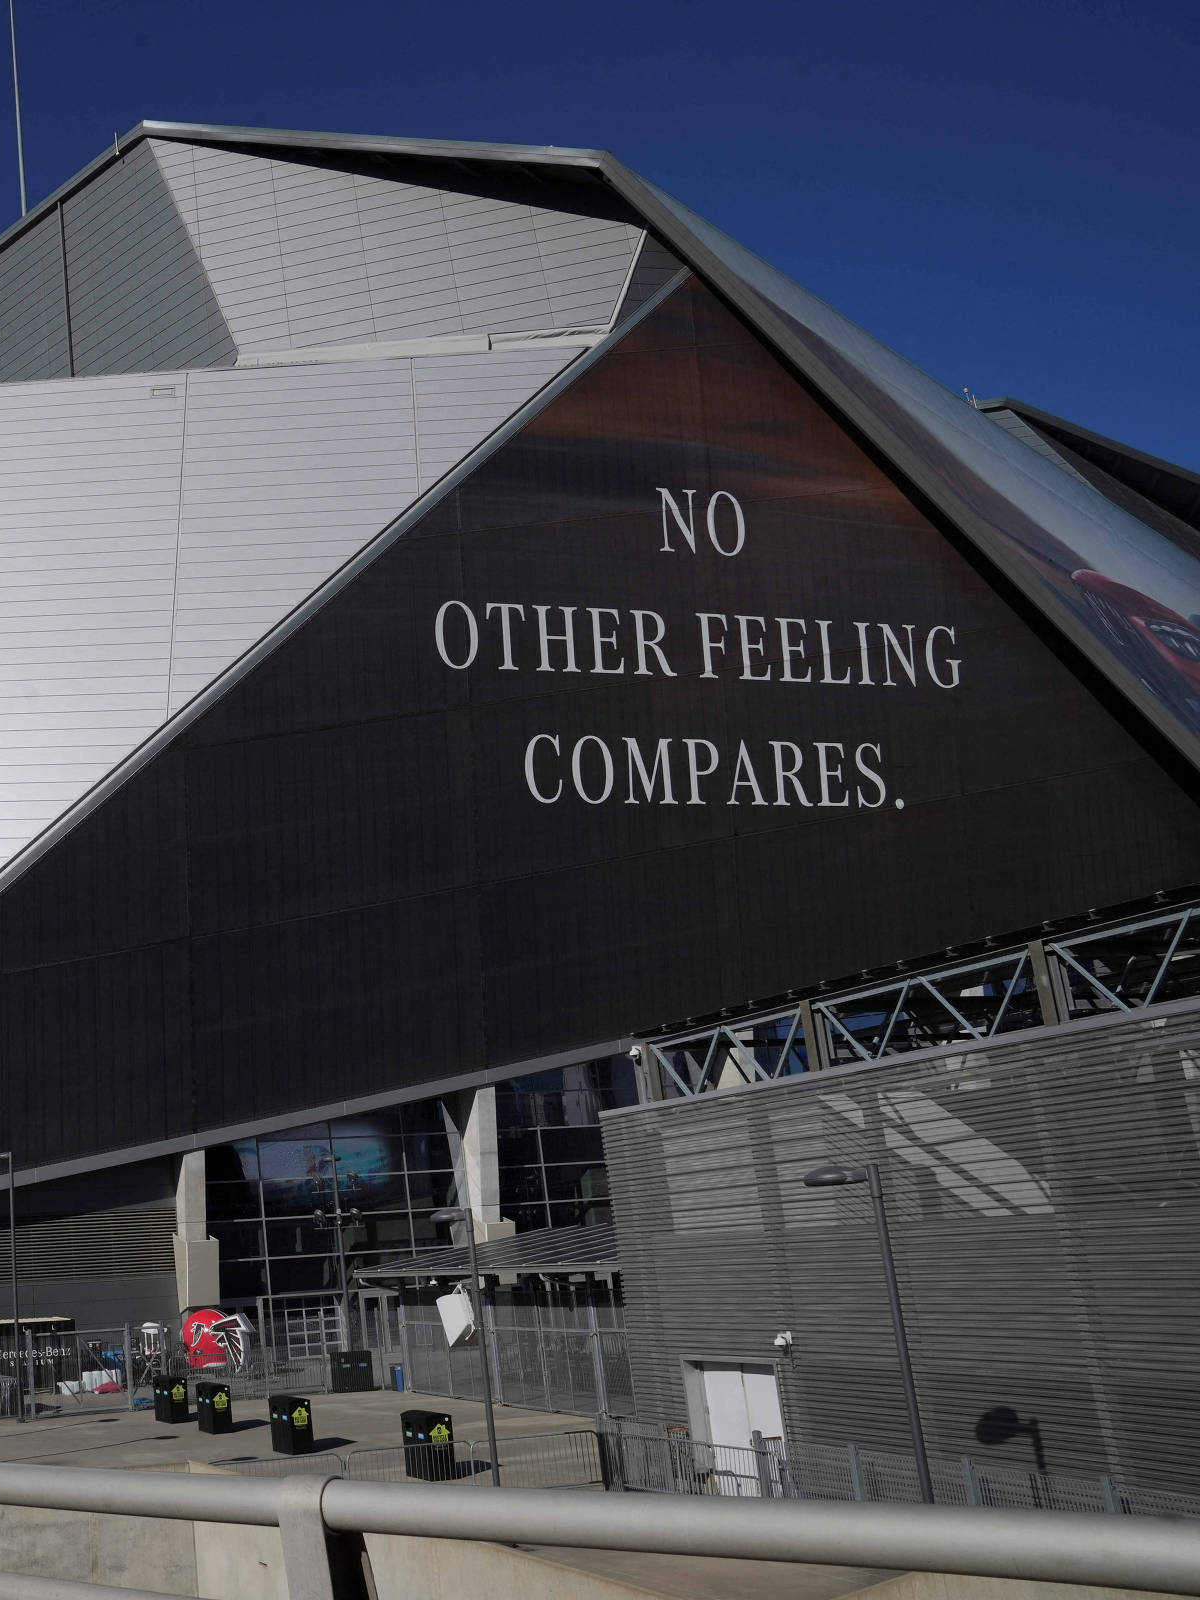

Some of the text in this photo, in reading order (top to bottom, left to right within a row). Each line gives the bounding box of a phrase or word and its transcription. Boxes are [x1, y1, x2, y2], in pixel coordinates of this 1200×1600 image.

[655, 487, 746, 557] NO
[434, 600, 962, 689] OTHER FEELING
[524, 733, 906, 810] COMPARES.
